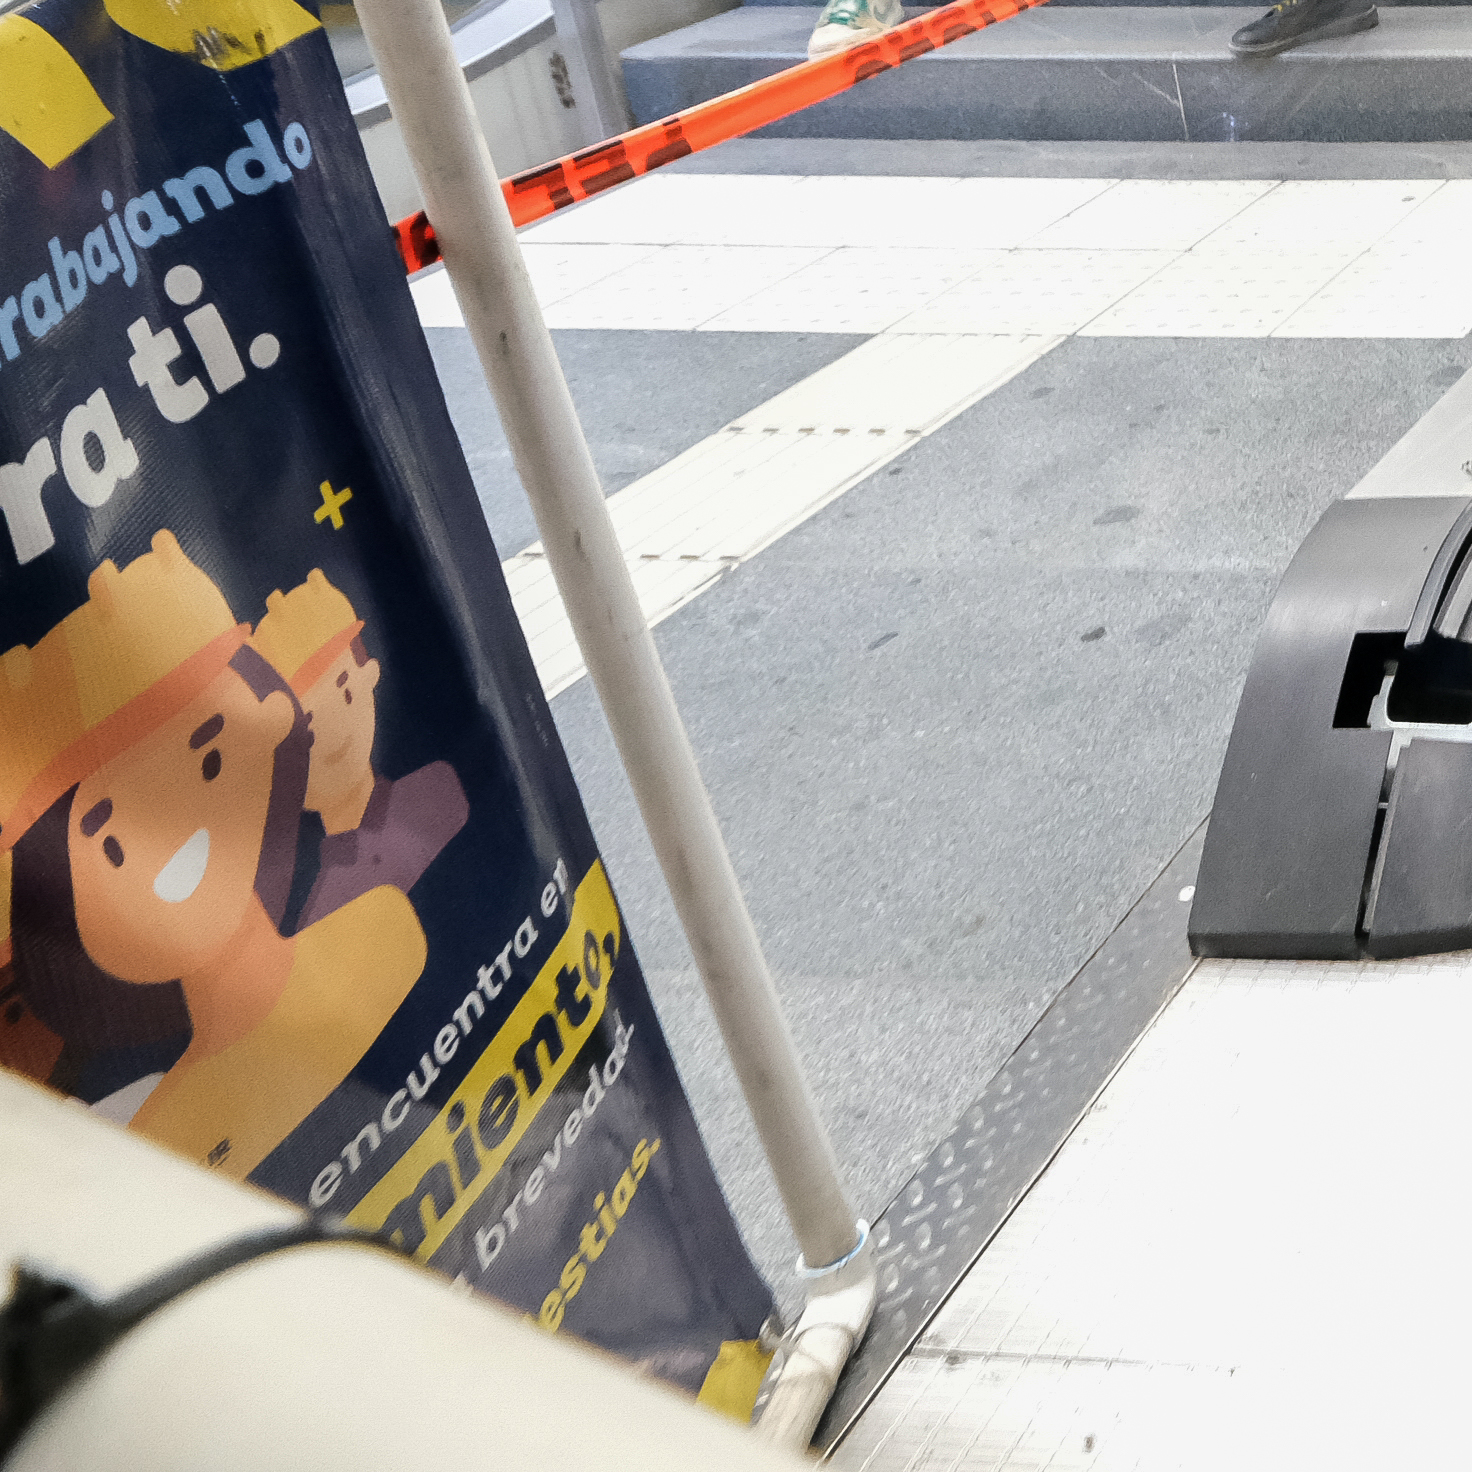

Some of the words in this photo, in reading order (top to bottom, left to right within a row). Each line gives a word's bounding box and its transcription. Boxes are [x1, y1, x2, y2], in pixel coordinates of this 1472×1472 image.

[0, 118, 313, 363] rabajando
[0, 387, 140, 565] ra
[127, 264, 281, 424] ti.
[309, 916, 539, 1208] encuentra
[378, 928, 616, 1258] miento,
[538, 1137, 662, 1334] estias.
